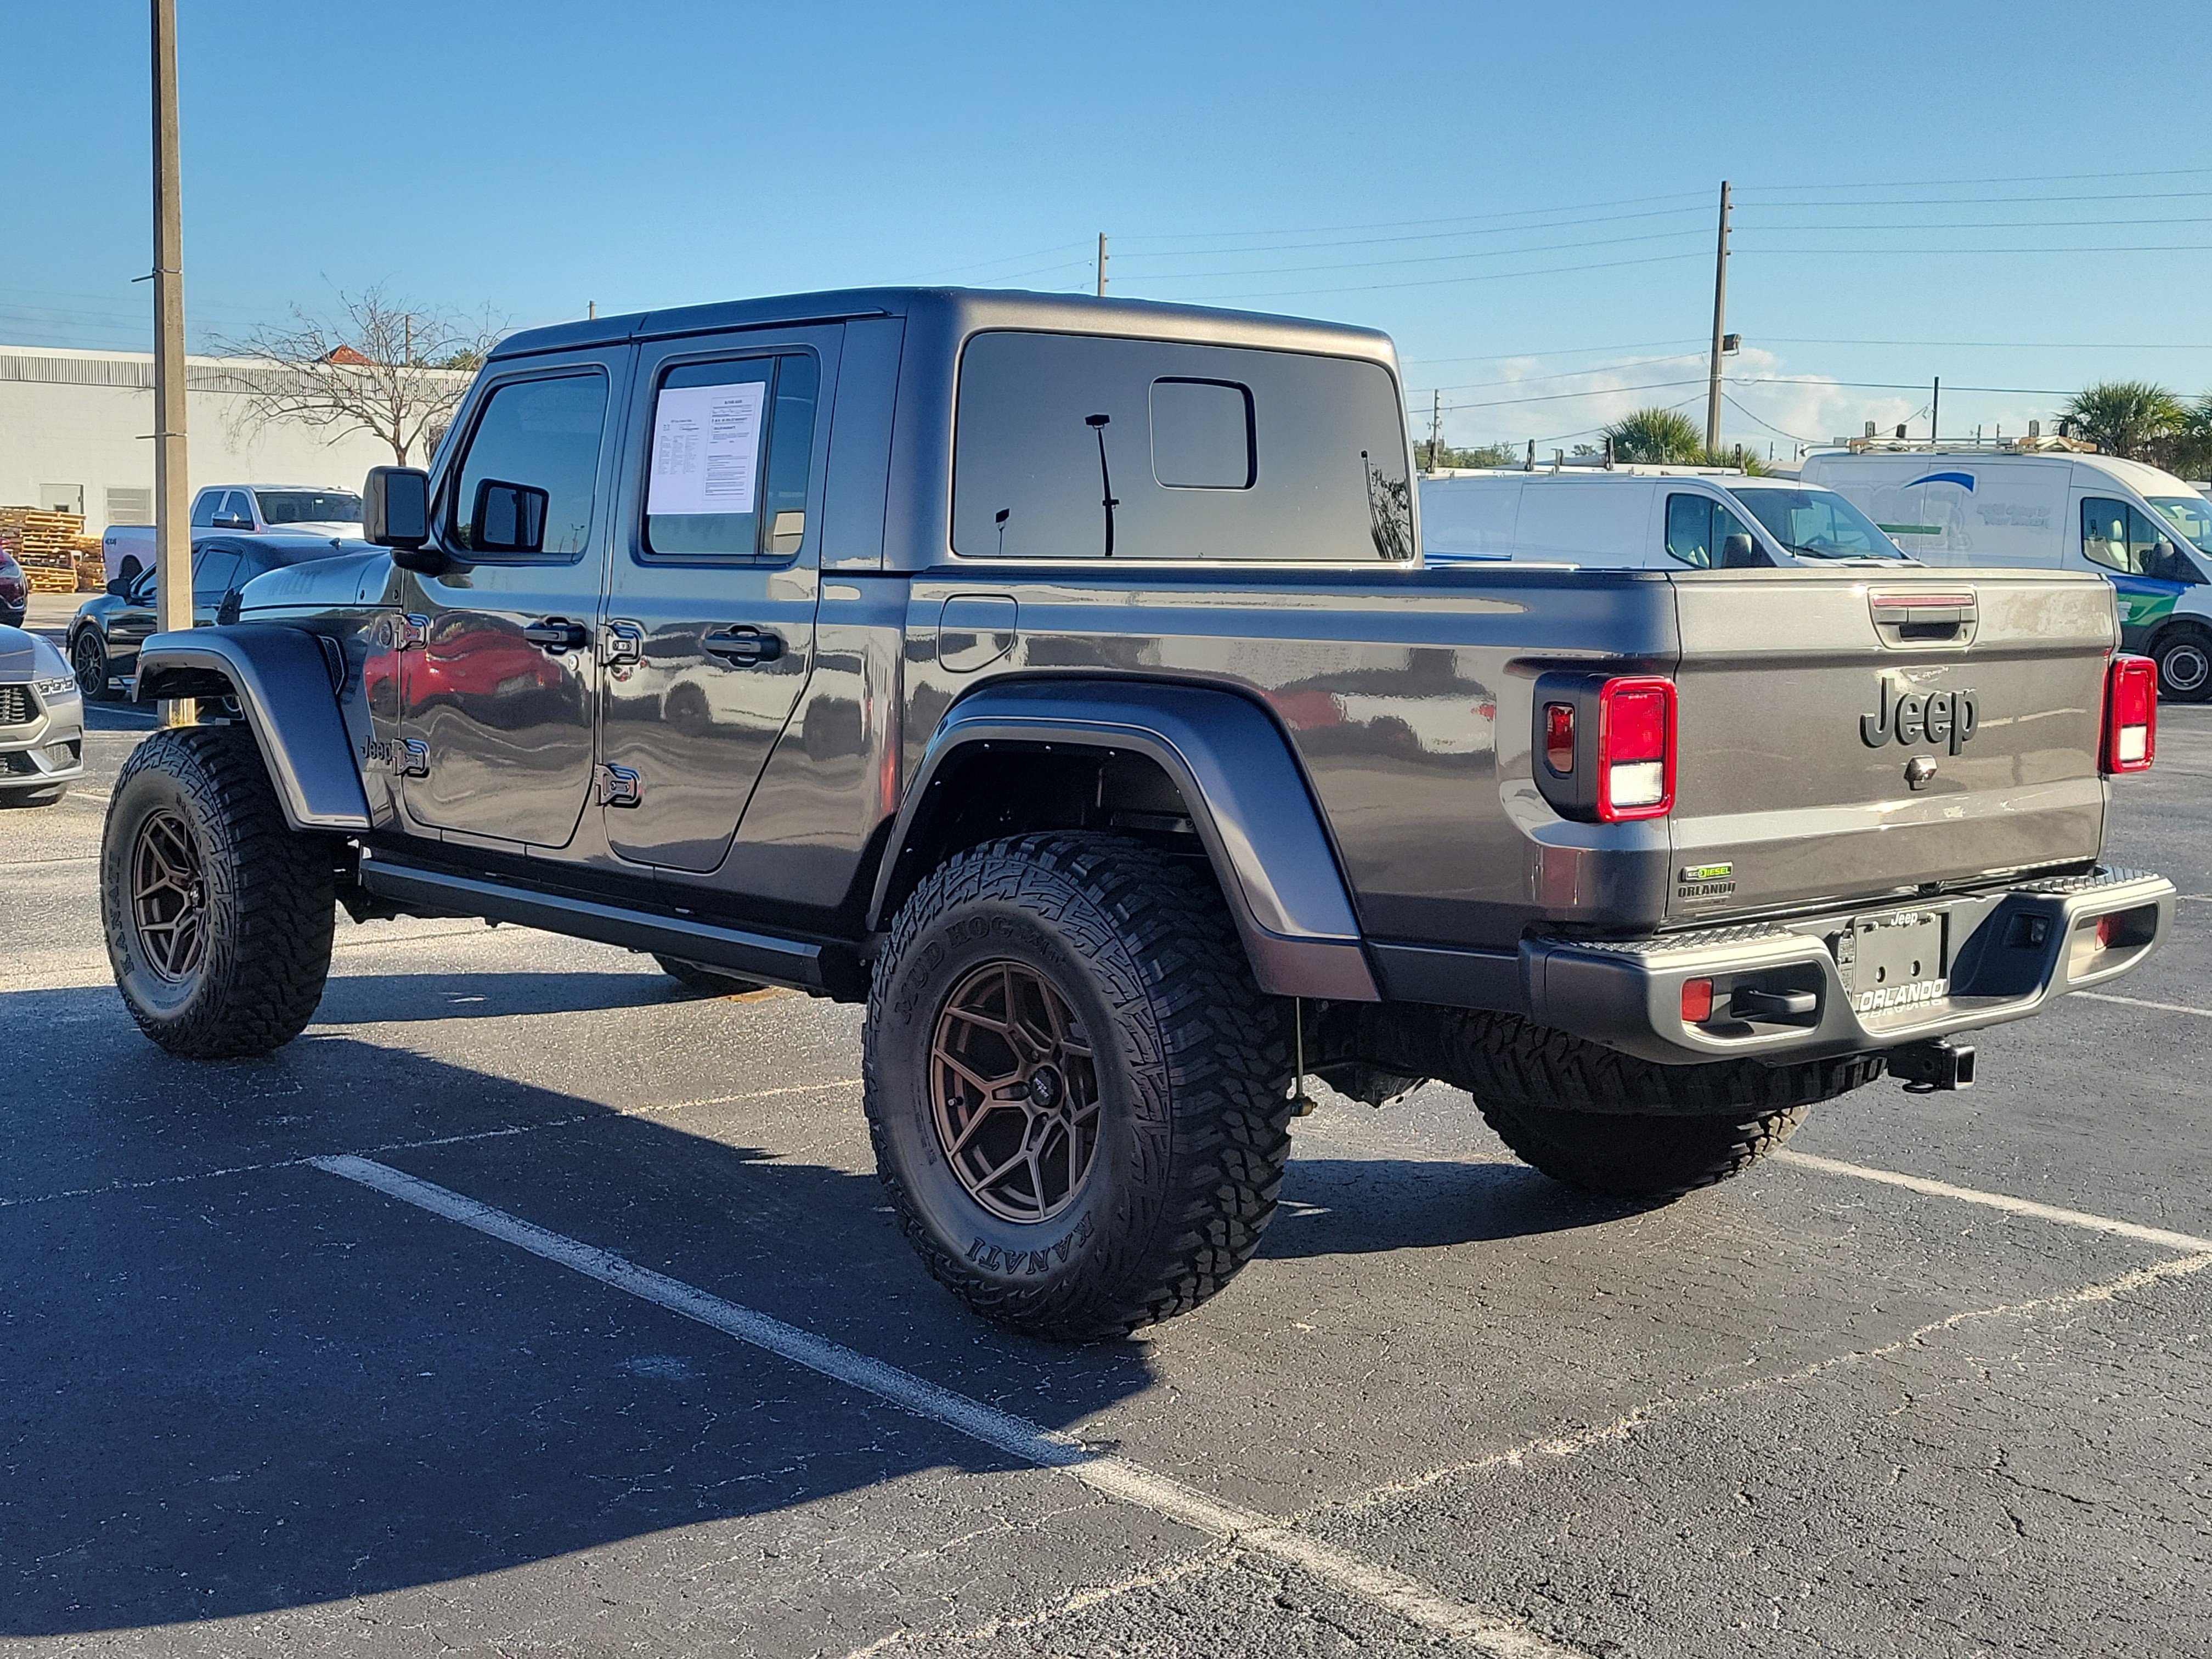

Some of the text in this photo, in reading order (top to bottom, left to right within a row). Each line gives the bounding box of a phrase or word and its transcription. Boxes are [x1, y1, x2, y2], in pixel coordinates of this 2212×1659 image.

[1859, 676, 1980, 756] Jeep
[360, 735, 392, 765] Jeep
[1678, 881, 1736, 898] ORLANDO
[945, 916, 1014, 949] HOG
[1891, 911, 1918, 926] Jeep
[1859, 979, 1945, 1012] ORLANDO
[964, 1210, 1095, 1275] KANATI
